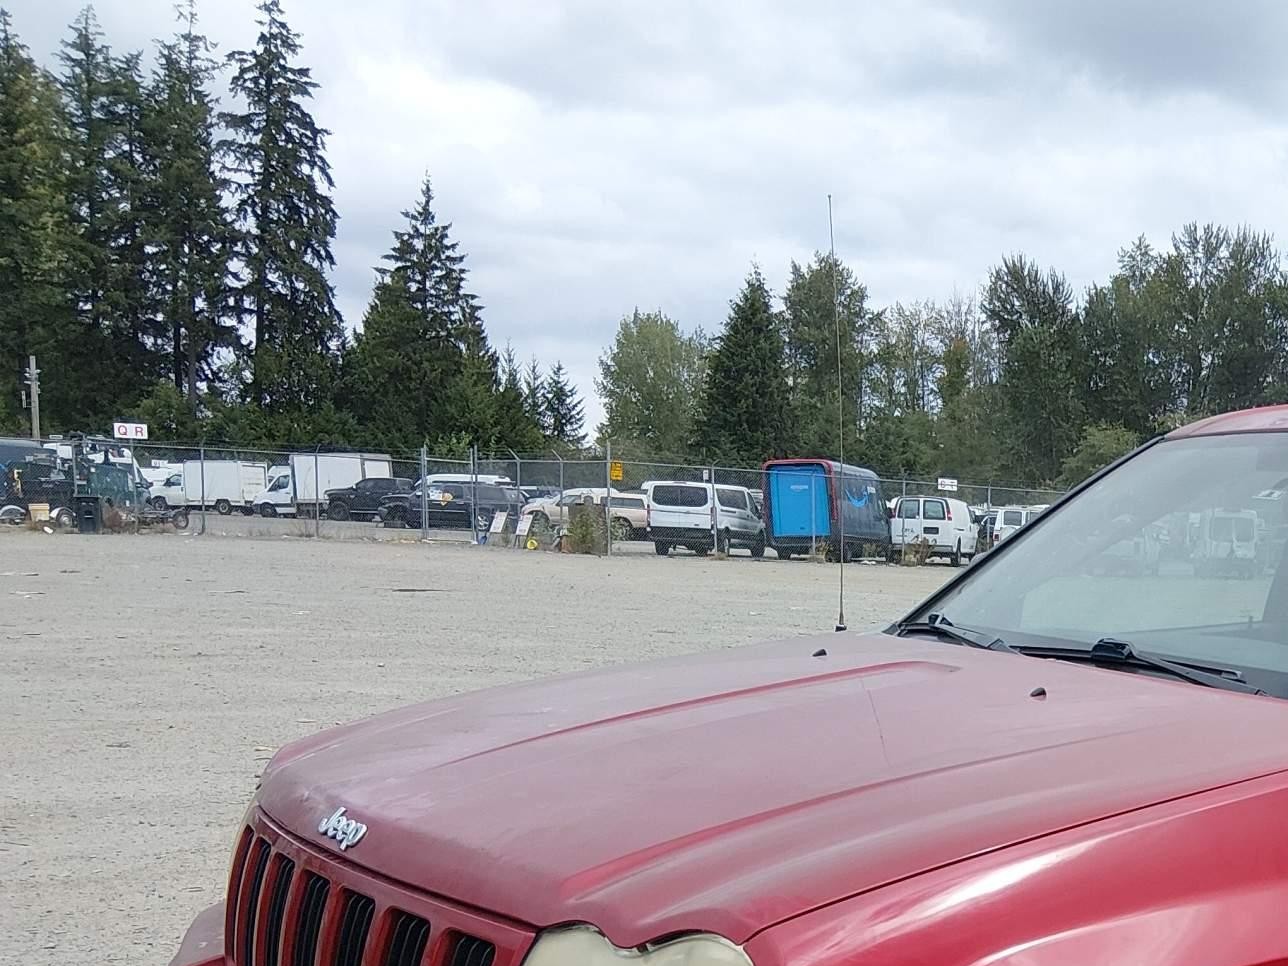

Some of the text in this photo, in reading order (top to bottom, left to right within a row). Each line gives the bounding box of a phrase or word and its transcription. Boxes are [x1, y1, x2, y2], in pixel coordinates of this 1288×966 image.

[117, 425, 144, 437] Q R
[318, 806, 369, 851] Jeep
